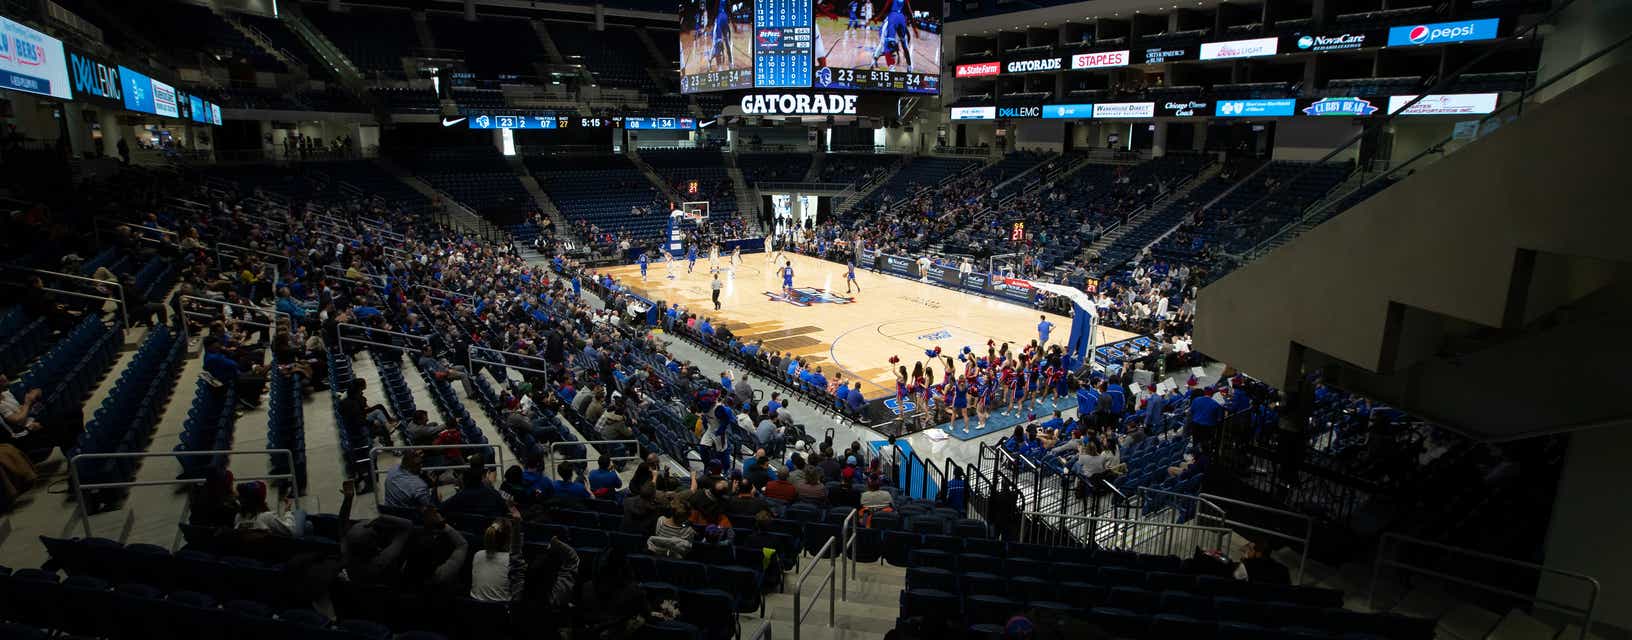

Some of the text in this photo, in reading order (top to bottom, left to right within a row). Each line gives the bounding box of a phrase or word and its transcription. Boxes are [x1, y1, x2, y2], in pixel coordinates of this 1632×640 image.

[1430, 24, 1474, 40] pepsi
[1313, 34, 1366, 45] NovaCare
[1008, 58, 1062, 72] GATORADE
[1078, 53, 1122, 66] STAPLES
[691, 76, 699, 86] 23
[729, 71, 738, 82] 34
[838, 70, 854, 81] 23
[871, 71, 889, 81] 5:15
[907, 74, 920, 85] 34
[741, 94, 858, 114] GATORADE
[1315, 101, 1366, 112] CUBBY BEAR
[582, 118, 600, 127] 5:15
[1012, 229, 1023, 240] 27
